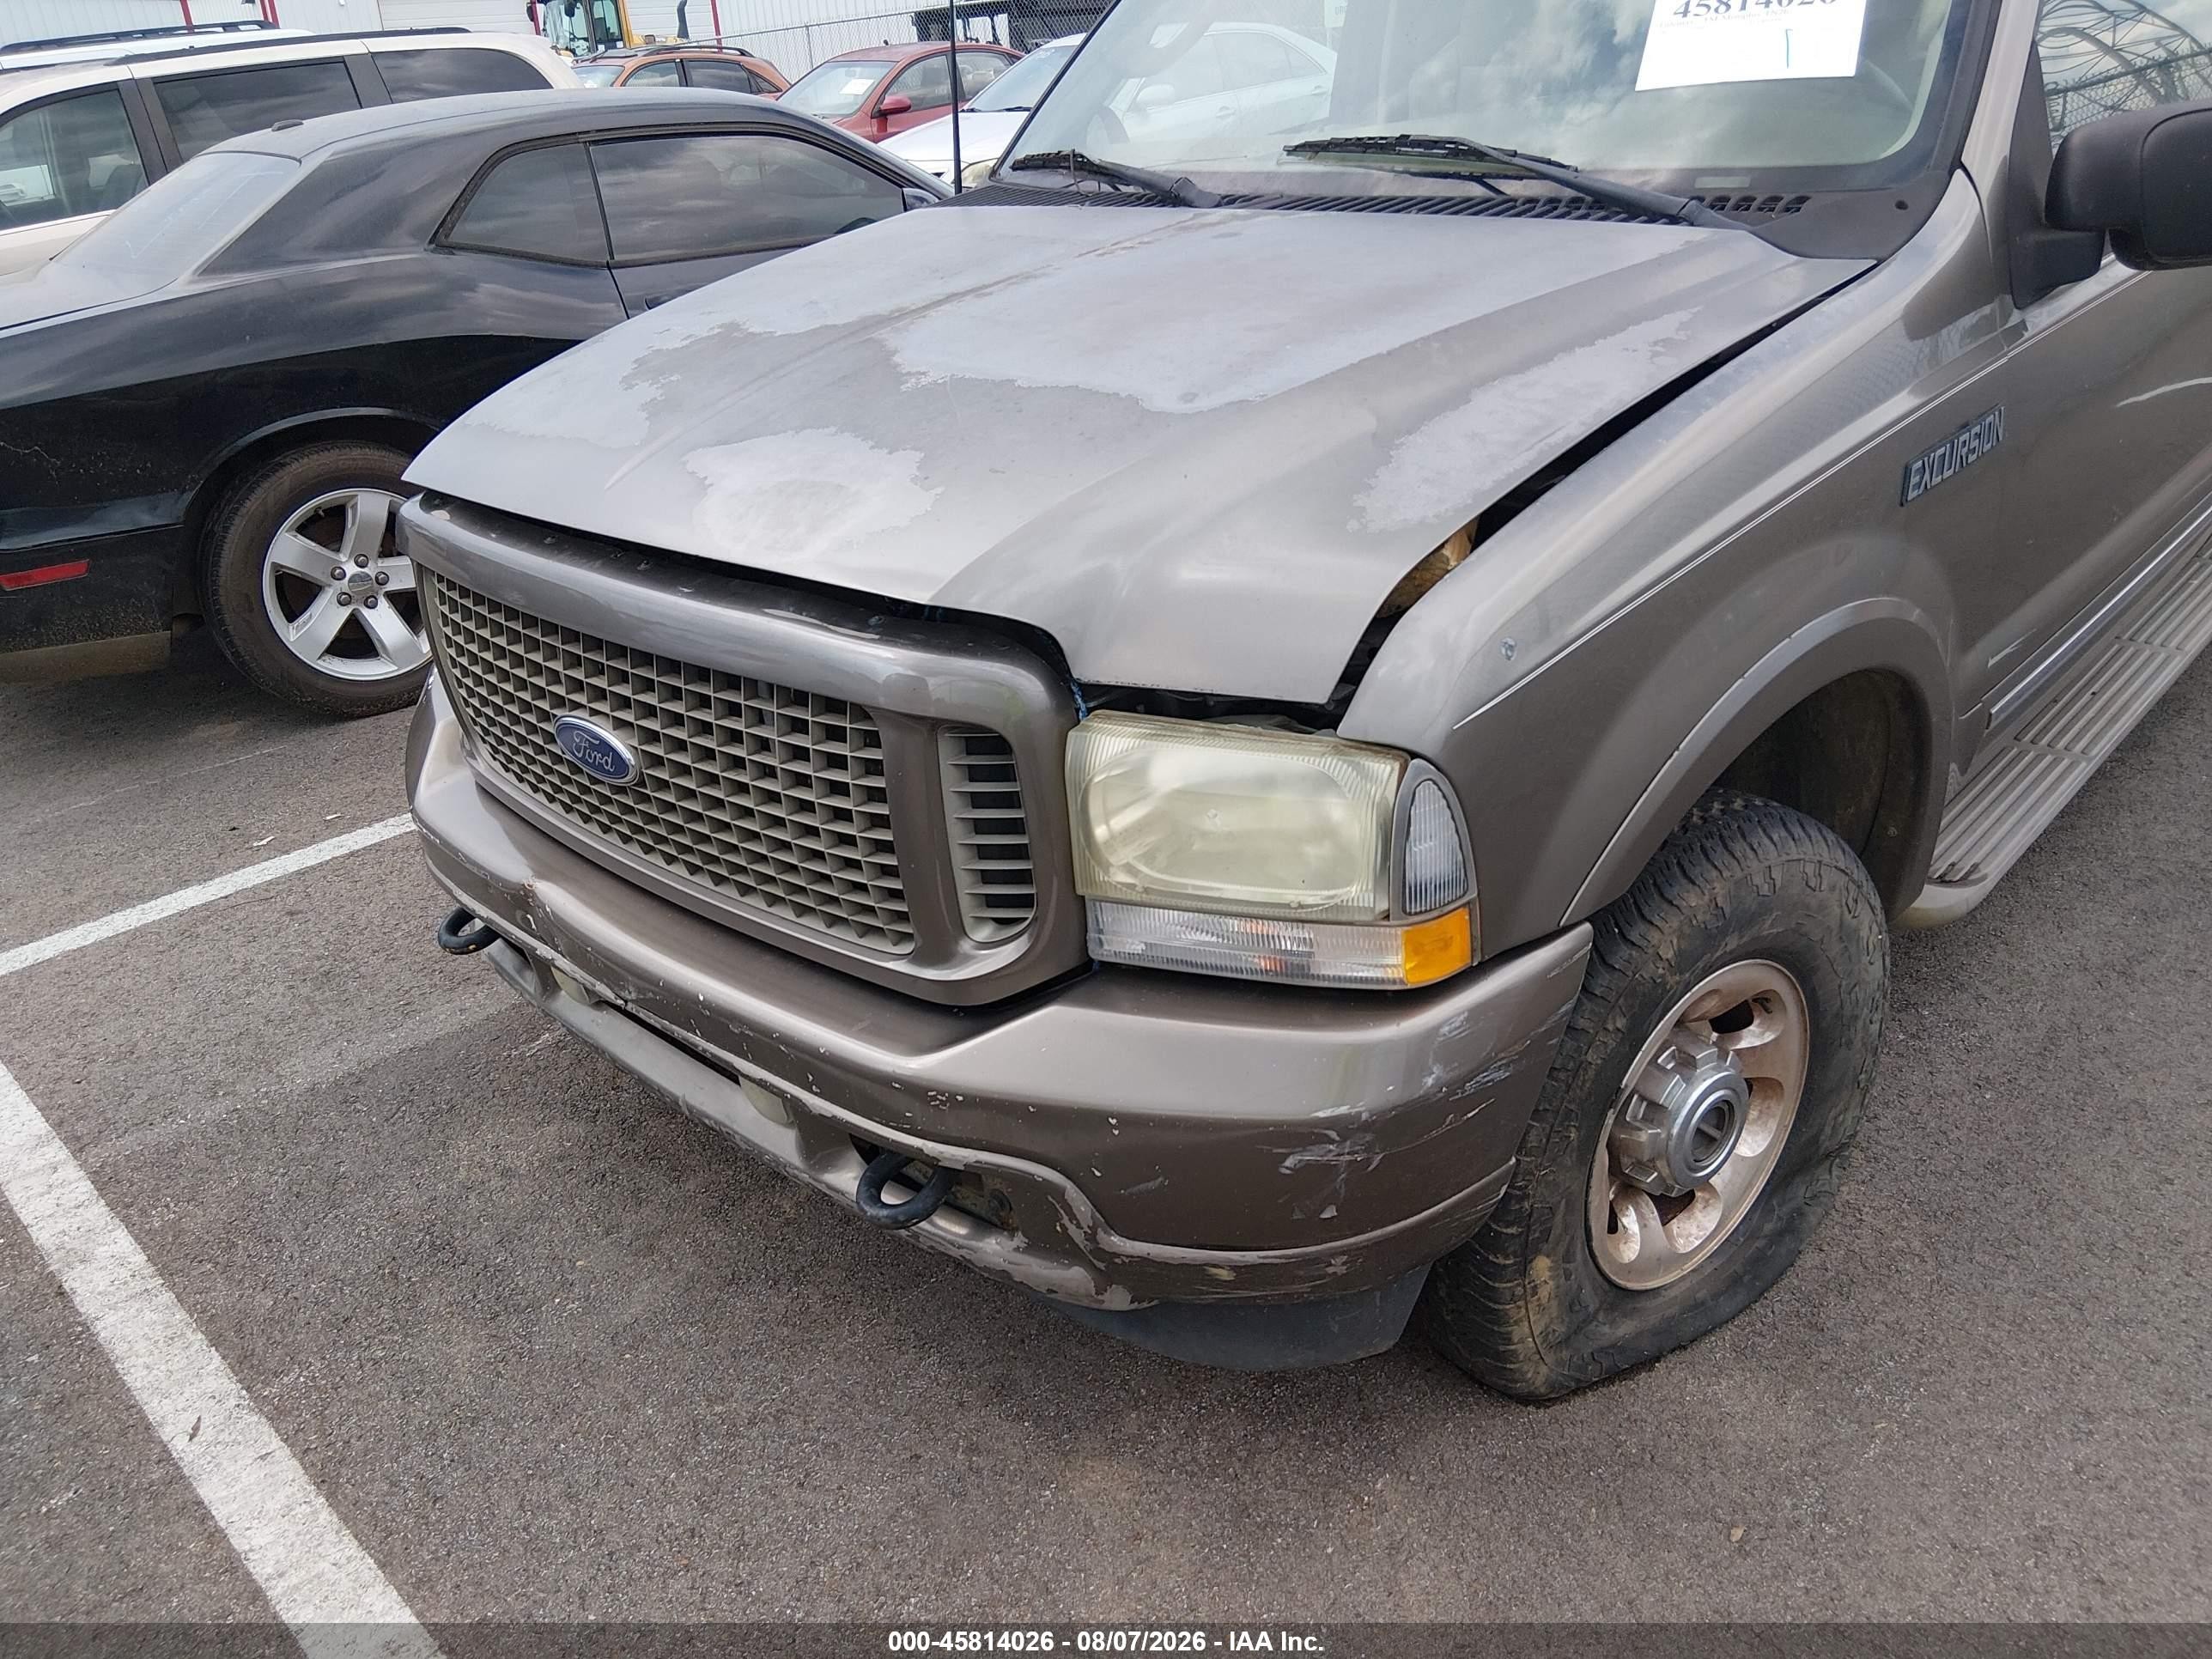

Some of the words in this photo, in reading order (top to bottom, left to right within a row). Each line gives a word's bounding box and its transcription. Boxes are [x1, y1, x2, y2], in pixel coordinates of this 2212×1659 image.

[1673, 0, 1837, 18] 4581
[1906, 406, 2006, 501] EXCURSION
[573, 730, 616, 773] Ford
